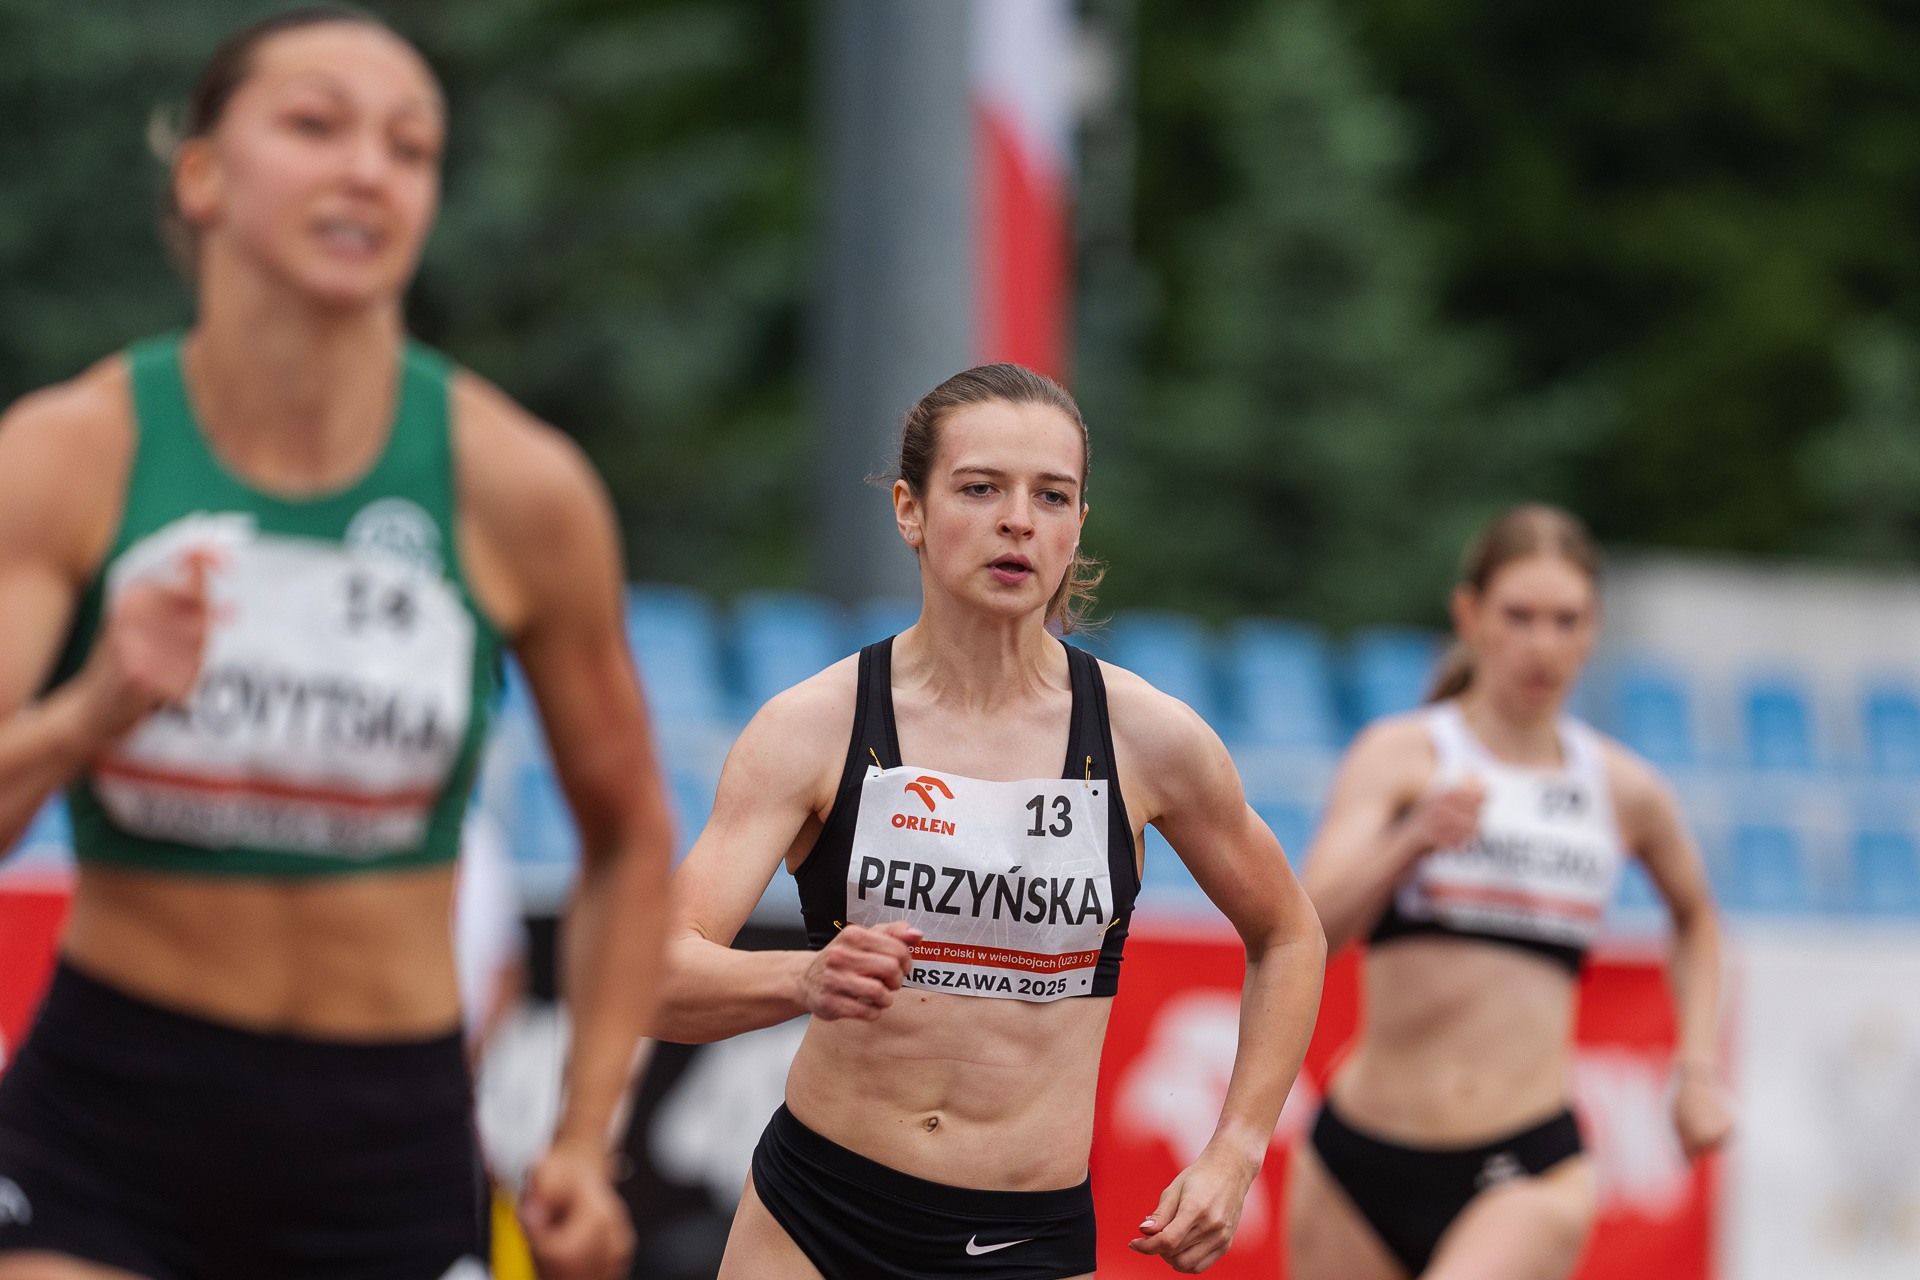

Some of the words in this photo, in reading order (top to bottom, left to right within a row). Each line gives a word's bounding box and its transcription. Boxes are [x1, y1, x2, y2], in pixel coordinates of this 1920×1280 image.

[891, 813, 956, 836] ORLEN
[1025, 794, 1073, 838] 13
[858, 855, 1104, 926] PERZYŃSKA
[907, 945, 941, 956] ostwa
[943, 947, 976, 959] Polski
[977, 952, 988, 960] w
[989, 951, 1055, 969] wielobojach
[1058, 955, 1078, 968] (U23
[903, 968, 1012, 993] RSZAWA
[1017, 978, 1067, 997] 2025
